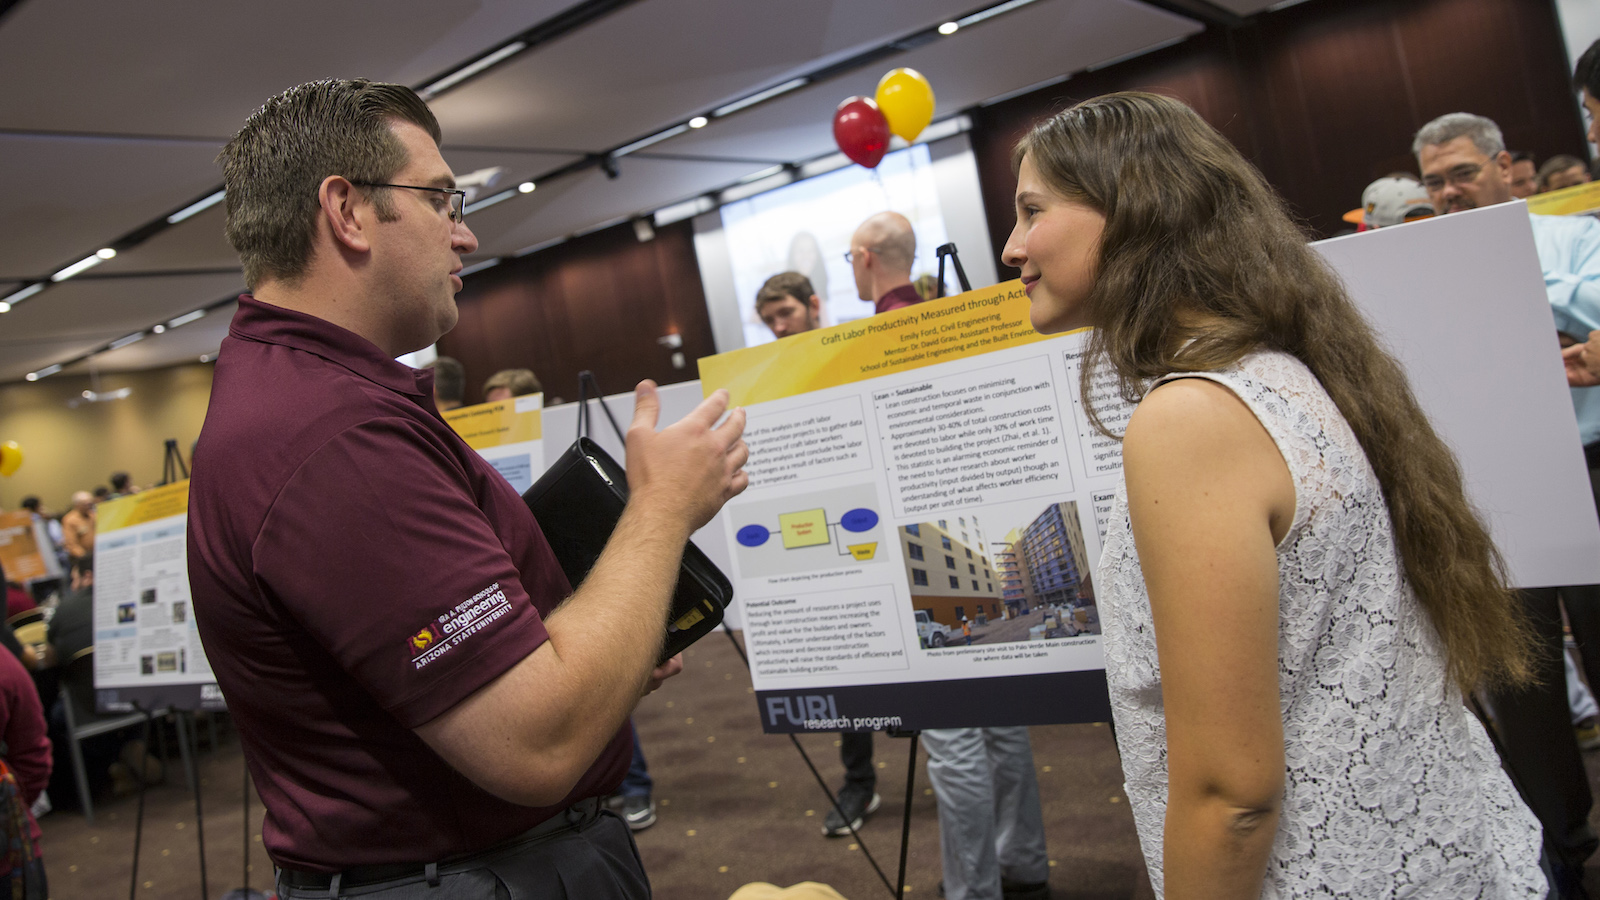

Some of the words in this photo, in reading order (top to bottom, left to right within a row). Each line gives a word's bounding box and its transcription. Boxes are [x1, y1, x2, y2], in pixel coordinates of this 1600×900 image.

[821, 333, 840, 345] Craft
[842, 328, 865, 340] Labor
[867, 316, 918, 333] Productivity
[920, 302, 966, 320] Measured
[967, 293, 1005, 309] through
[1007, 287, 1027, 300] Acti
[900, 332, 919, 341] Emily
[920, 326, 939, 336] Ford,
[940, 322, 955, 332] Civil
[956, 313, 1001, 328] Engineering
[860, 363, 880, 372] School
[889, 353, 924, 365] Sustainable
[926, 344, 965, 357] Engineering
[966, 340, 978, 348] and
[992, 333, 1008, 342] Built
[1009, 325, 1036, 338] Environ
[884, 346, 908, 355] Mentor:
[920, 338, 939, 348] David
[959, 327, 989, 338] Assistant
[990, 319, 1022, 331] Professor
[887, 409, 916, 419] economic
[918, 405, 930, 413] and
[931, 398, 961, 410] temporal
[962, 395, 982, 404] waste
[991, 385, 1032, 398] conjunction
[1033, 381, 1050, 390] with
[895, 383, 932, 396] Sustainable
[901, 393, 941, 405] construction
[941, 388, 967, 397] focuses
[978, 377, 1016, 390] minimizing
[888, 415, 934, 429] environmental
[890, 426, 936, 440] Approximately
[938, 421, 962, 431] 30-40%
[971, 415, 987, 424] total
[988, 408, 1032, 421] construction
[1032, 404, 1051, 413] costs
[904, 437, 930, 448] devoted
[958, 429, 976, 438] while
[977, 426, 992, 434] only
[994, 423, 1008, 432] 30%
[1009, 420, 1016, 429] of
[1018, 418, 1036, 427] work
[1088, 414, 1121, 426] rorded
[900, 449, 926, 459] devoted
[935, 444, 963, 453] building
[976, 436, 1000, 447] project
[910, 460, 934, 468] statistic
[952, 451, 981, 461] alarming
[982, 445, 1015, 456] economic
[1016, 439, 1049, 450] reminder
[1050, 436, 1058, 444] of
[1092, 440, 1123, 449] measure
[1094, 450, 1123, 461] significa
[900, 481, 937, 492] productivity
[939, 477, 958, 486] (input
[960, 472, 984, 482] divided
[995, 466, 1022, 476] output)
[1022, 462, 1048, 472] though
[935, 466, 958, 474] further
[960, 460, 988, 470] research
[990, 457, 1010, 466] about
[1011, 453, 1035, 462] worker
[1096, 462, 1123, 472] resultin
[902, 490, 948, 502] understanding
[975, 482, 998, 490] affects
[998, 478, 1022, 487] worker
[1024, 473, 1058, 483] efficiency
[1094, 494, 1114, 502] Exam
[903, 503, 927, 513] (output
[443, 590, 506, 634] engineering
[416, 643, 452, 670] ARIZONA
[452, 627, 476, 646] STATE
[476, 604, 512, 630] UNIVERSITY
[766, 694, 838, 726] FURI
[803, 715, 851, 730] research
[853, 715, 902, 731] program
